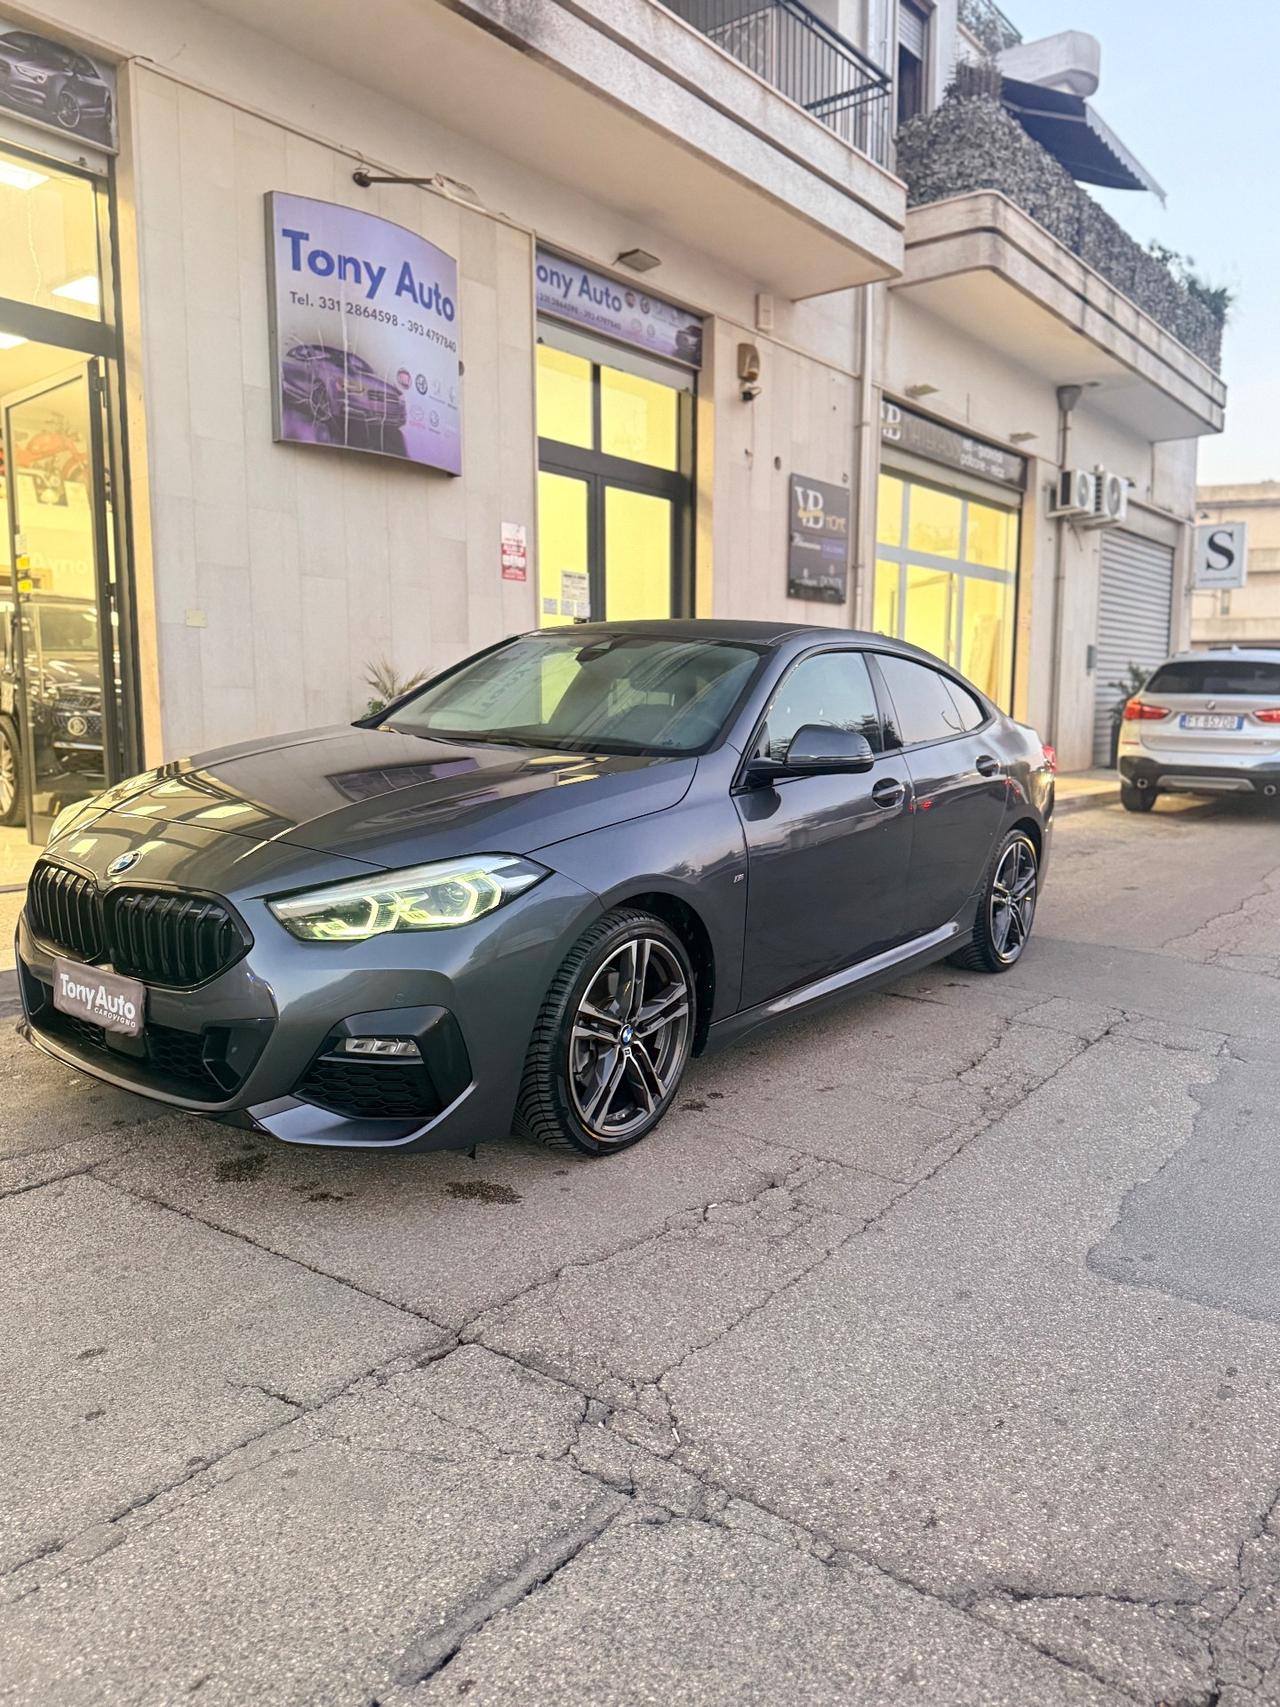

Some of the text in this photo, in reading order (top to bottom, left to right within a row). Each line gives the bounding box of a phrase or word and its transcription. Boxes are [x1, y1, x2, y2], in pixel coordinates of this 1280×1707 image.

[281, 228, 455, 322] Tony Auto
[536, 265, 622, 312] ony Auto
[289, 291, 314, 308] Tel.
[319, 296, 341, 312] 331
[345, 301, 398, 327] 2864598
[407, 320, 424, 336] 393
[425, 330, 456, 352] 4797840
[1205, 530, 1235, 572] S
[94, 1007, 136, 1028] CAROVIGNO
